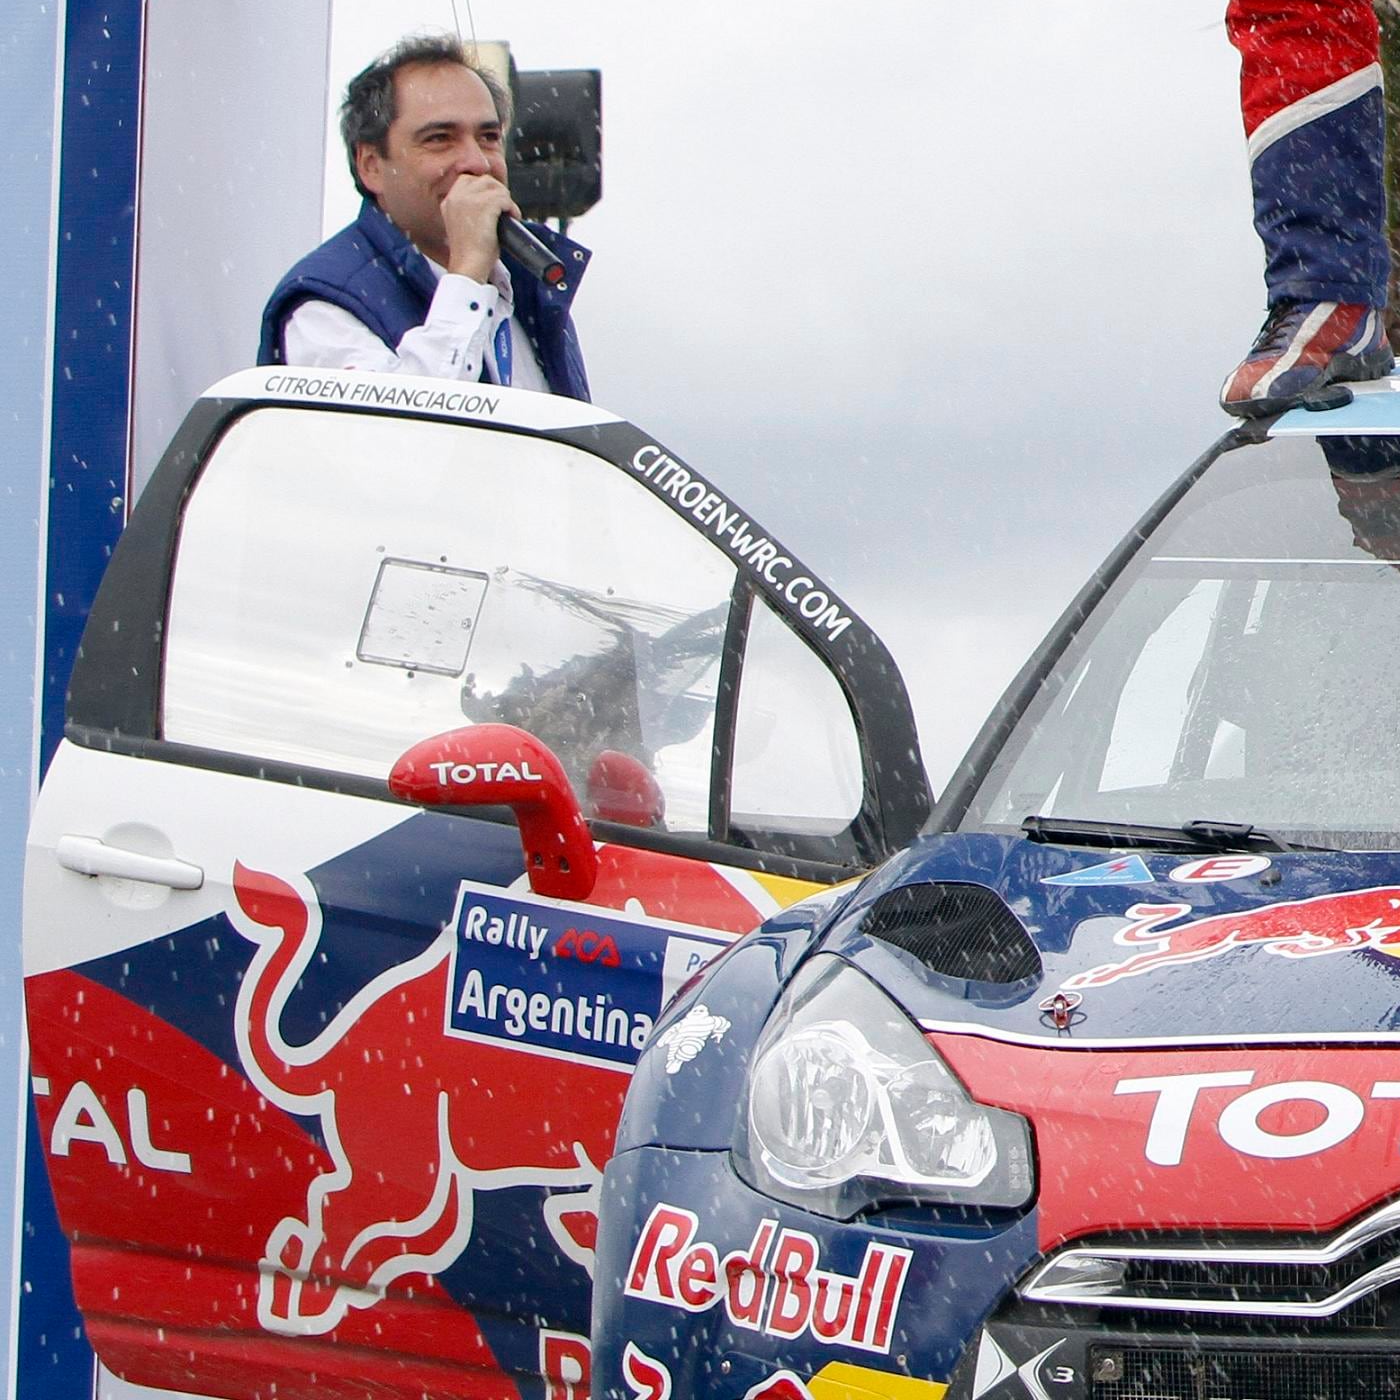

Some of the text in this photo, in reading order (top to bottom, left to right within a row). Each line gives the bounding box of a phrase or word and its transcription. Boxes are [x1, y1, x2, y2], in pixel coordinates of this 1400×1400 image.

[350, 383, 501, 416] FINANCIACION
[632, 445, 853, 642] CITROEN-WRC.COM
[429, 760, 543, 786] TOTAL
[464, 905, 549, 960] Rally
[457, 968, 656, 1051] Argentina
